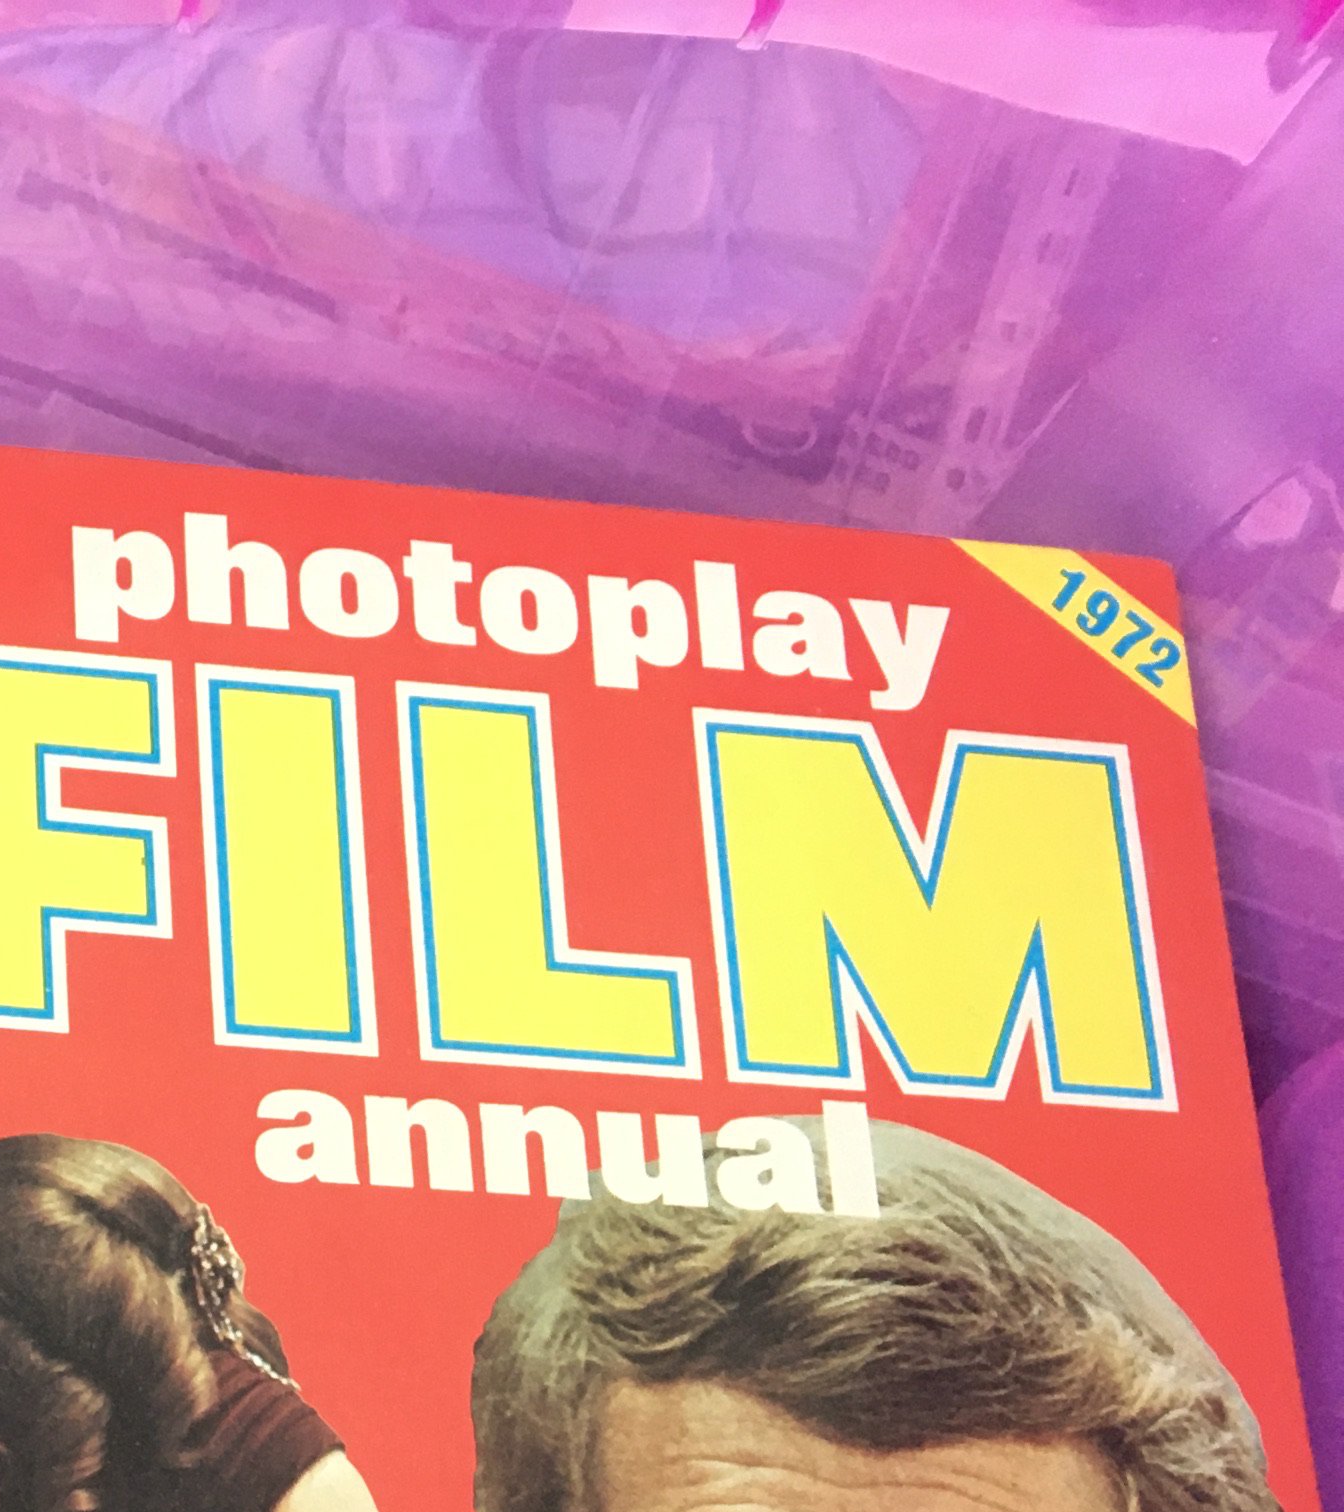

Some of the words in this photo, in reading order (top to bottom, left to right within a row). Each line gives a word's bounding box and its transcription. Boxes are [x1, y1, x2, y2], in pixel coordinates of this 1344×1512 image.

[72, 513, 950, 710] photoplay
[1056, 565, 1182, 689] 1972
[254, 1087, 881, 1219] annual
